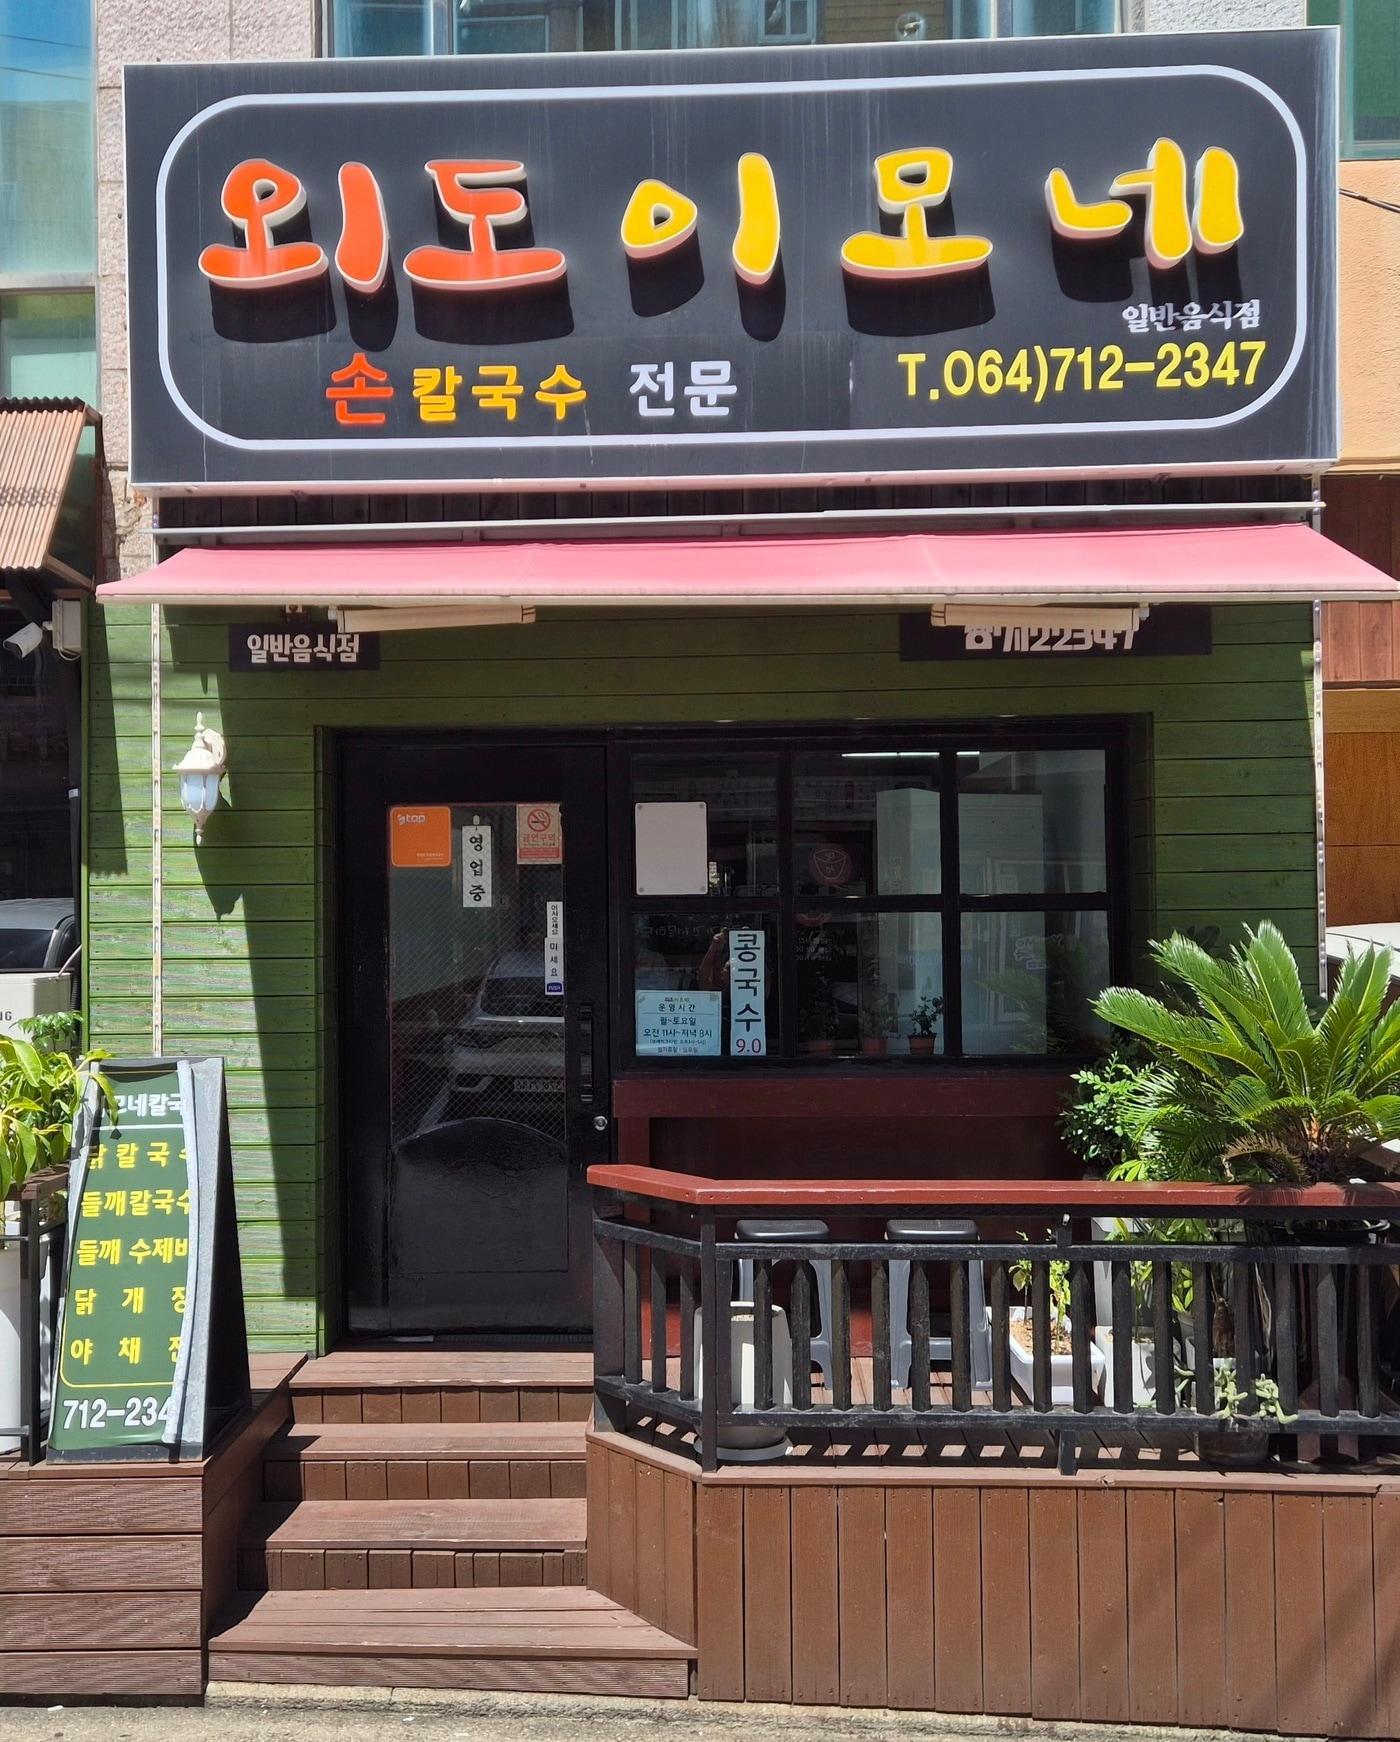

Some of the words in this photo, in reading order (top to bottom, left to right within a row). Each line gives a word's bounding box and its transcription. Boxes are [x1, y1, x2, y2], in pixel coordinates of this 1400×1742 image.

[1122, 300, 1261, 333] 일반음식점
[629, 360, 738, 416] 전문
[247, 634, 360, 663] 일반음식점
[736, 1038, 761, 1053] 9.0
[77, 1238, 121, 1266] 들깨
